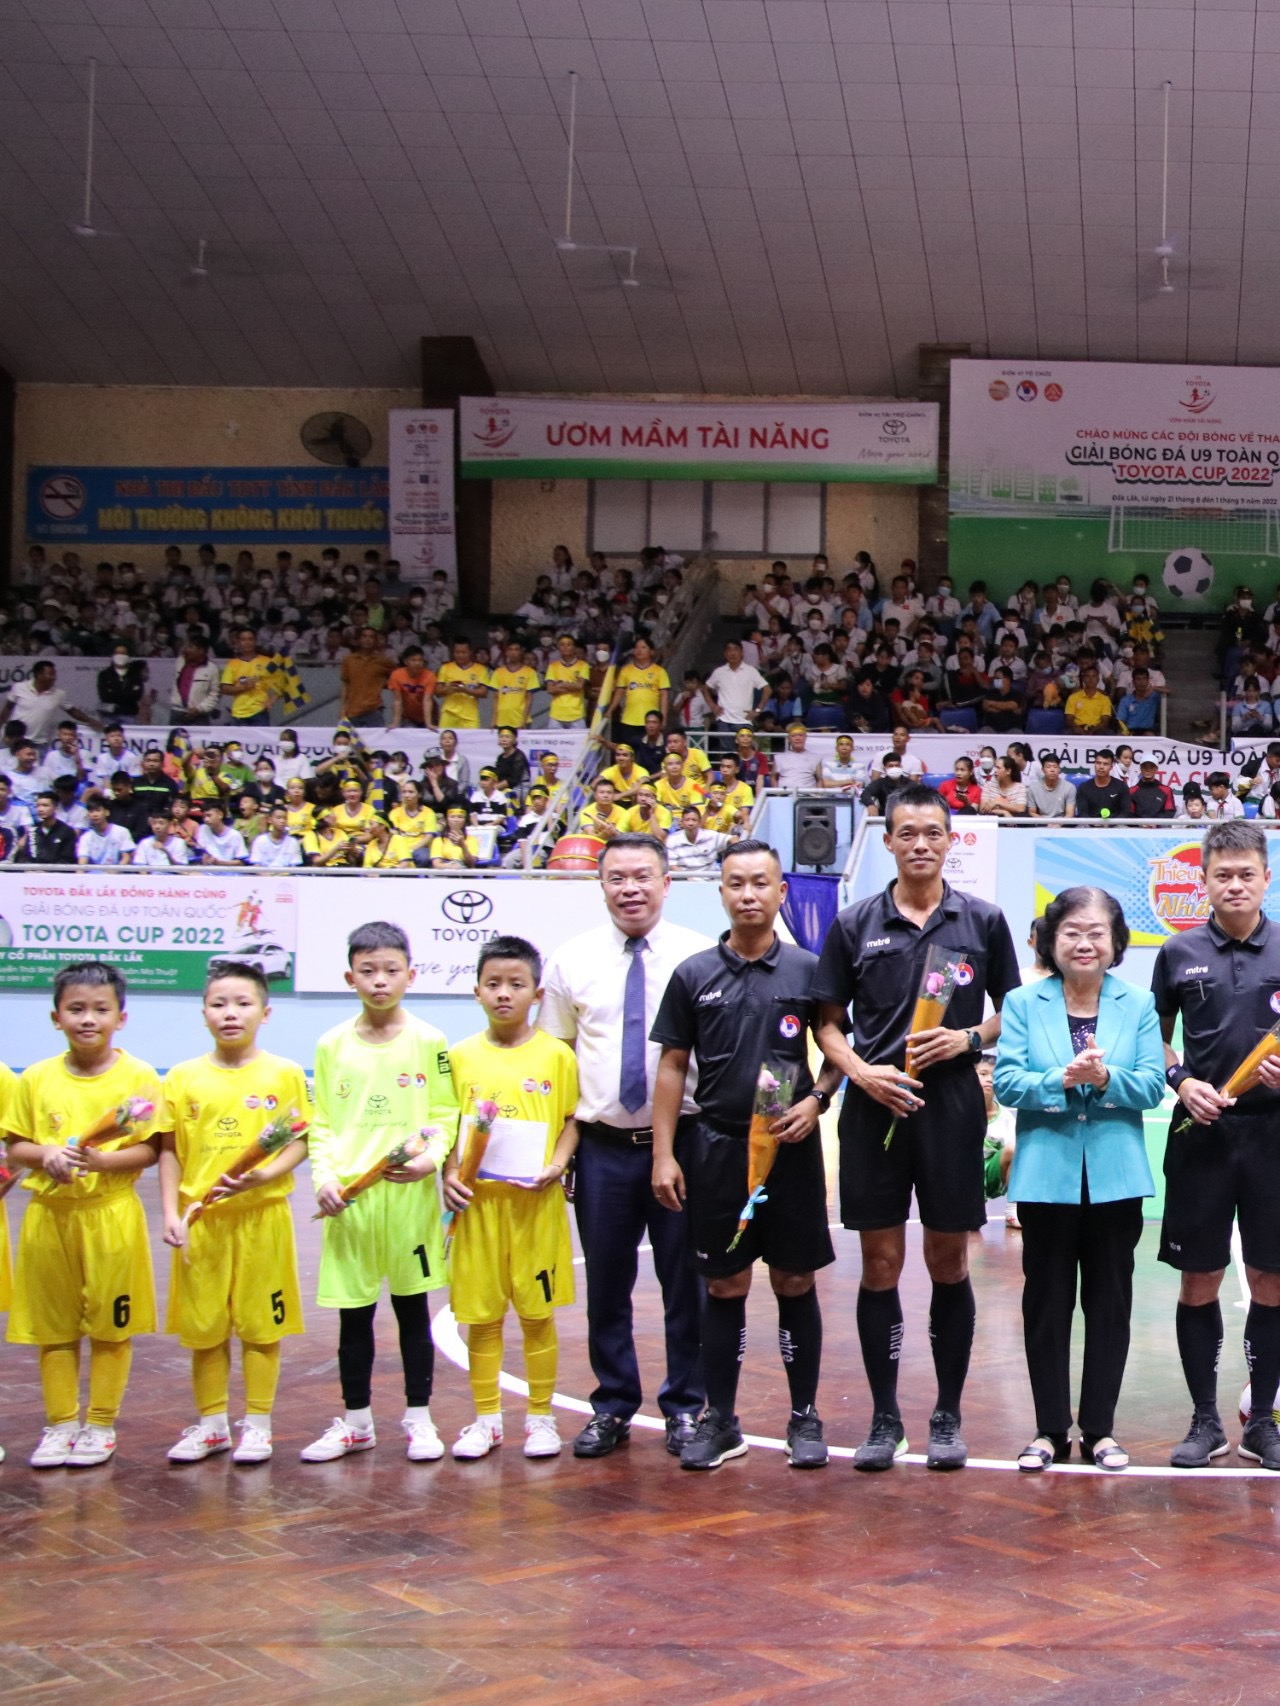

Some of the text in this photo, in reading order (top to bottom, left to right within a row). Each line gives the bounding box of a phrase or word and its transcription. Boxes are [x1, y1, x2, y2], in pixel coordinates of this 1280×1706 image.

[547, 418, 829, 449] ƯƠM MẦM TÀI NĂNG
[1077, 428, 1109, 440] CHÀO
[1113, 429, 1148, 441] MỪNG
[1152, 429, 1175, 441] CÁC
[1178, 430, 1199, 442] ĐỘI
[1203, 430, 1236, 442] BÓNG
[1071, 441, 1105, 459] GIẢI
[1110, 443, 1156, 461] BÓNG
[1162, 444, 1186, 461] ĐÁ
[1191, 449, 1212, 461] U9
[1217, 446, 1261, 463] TOÀN
[1117, 464, 1270, 480] TOYOTA CUP 2022
[1152, 745, 1180, 766] ĐÁ
[1187, 750, 1212, 766] U9
[24, 884, 226, 900] TOYOTA ĐẮK LẮK ĐỒNG HÀNH CÙNG
[22, 902, 227, 919] GIẢI BÓNG ĐÁ U9 TOÀN QUỐC
[22, 924, 225, 945] TOYOTA CUP 2022
[432, 929, 500, 942] TOYOTA
[866, 936, 891, 948] mitre
[8, 948, 25, 960] CỔ
[28, 948, 56, 961] PHẦN
[123, 950, 144, 962] LẮK
[413, 961, 443, 974] ove
[1185, 965, 1209, 975] mitre
[413, 1244, 430, 1278] 1
[113, 1294, 131, 1328] 6
[271, 1290, 285, 1325] 5
[779, 1328, 798, 1363] mitre
